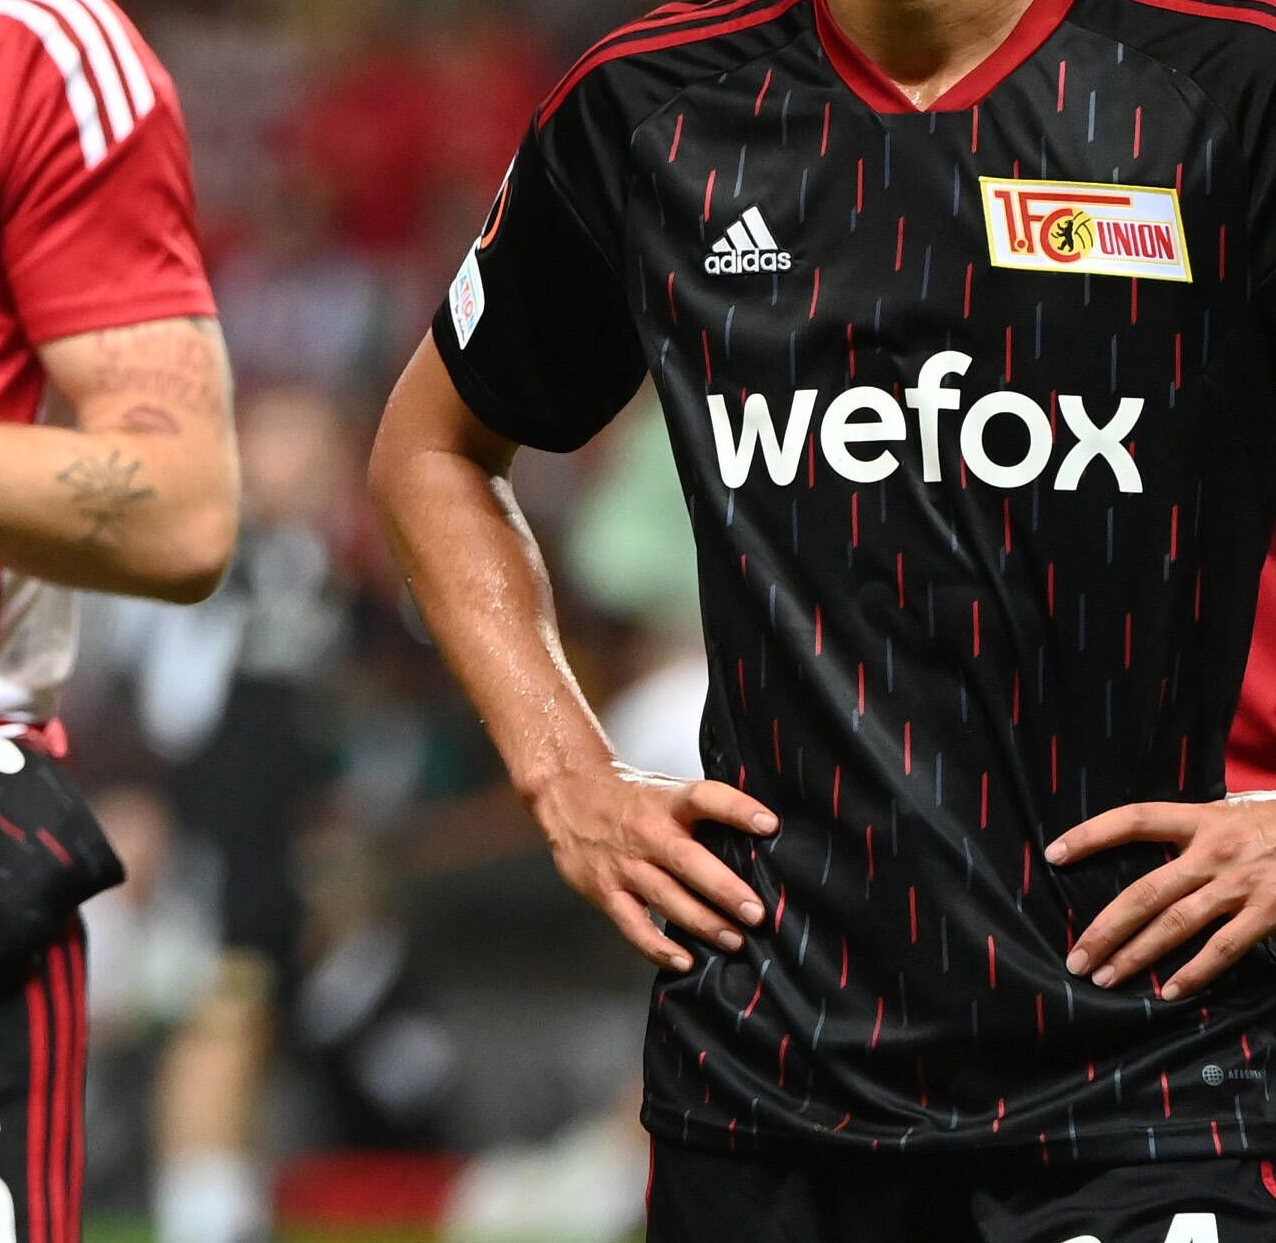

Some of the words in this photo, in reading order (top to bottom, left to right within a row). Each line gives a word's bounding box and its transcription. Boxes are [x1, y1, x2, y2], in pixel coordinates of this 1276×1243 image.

[704, 244, 792, 275] adidas
[1097, 220, 1175, 260] UNION
[707, 350, 1145, 493] wefox
